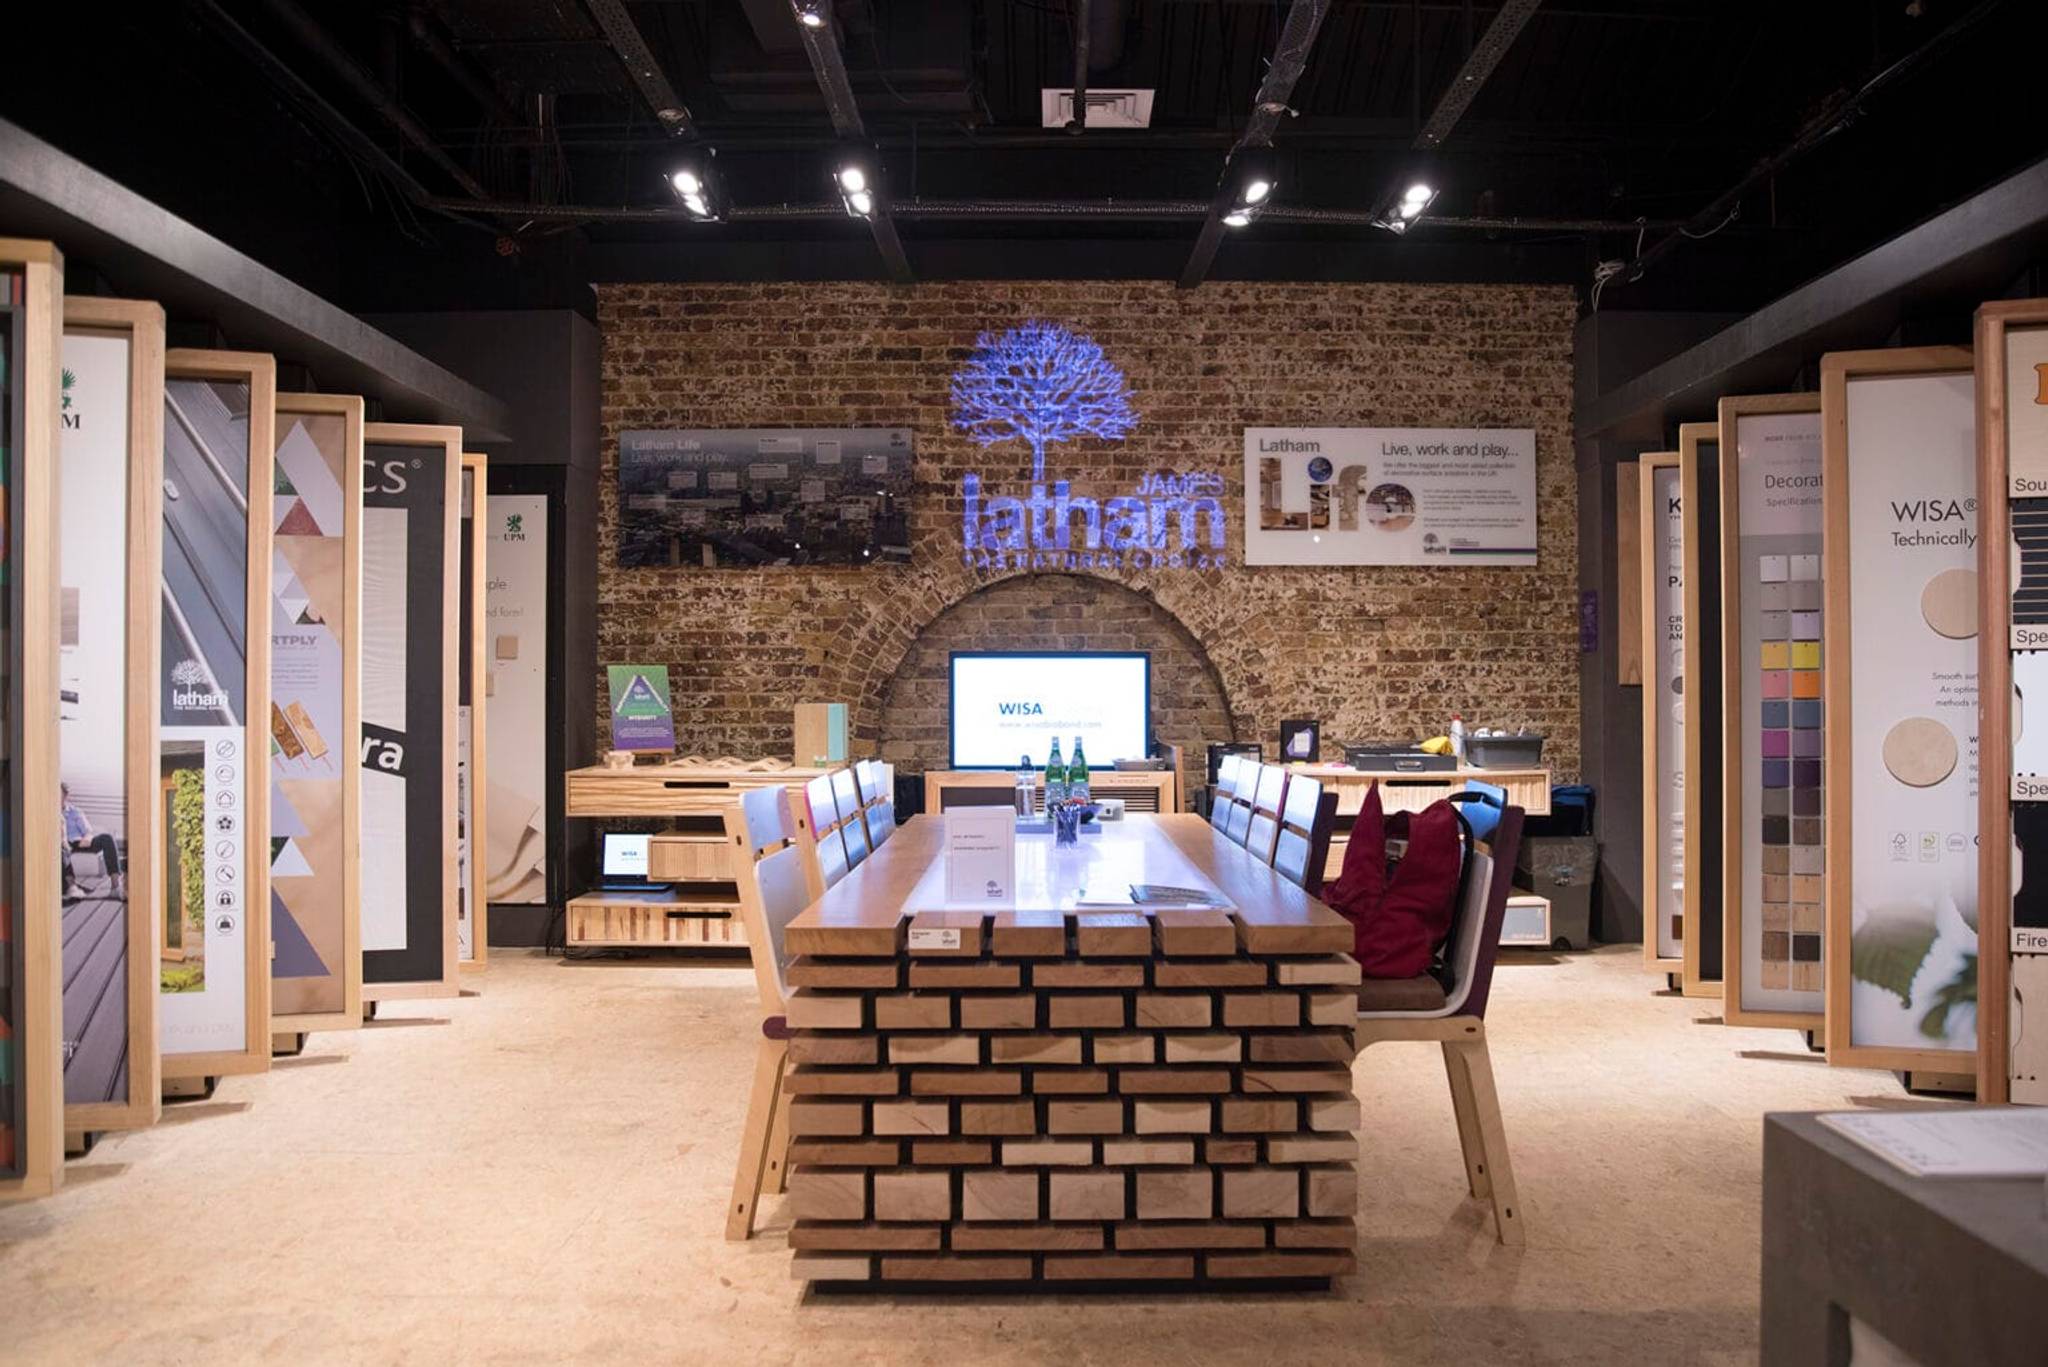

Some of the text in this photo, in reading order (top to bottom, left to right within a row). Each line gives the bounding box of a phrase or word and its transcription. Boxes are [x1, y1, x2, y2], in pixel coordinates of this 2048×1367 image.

[1259, 438, 1321, 453] Latham
[1382, 442, 1412, 457] Live,
[1415, 443, 1450, 456] work
[1452, 443, 1478, 456] and
[2015, 478, 2048, 492] Sou
[962, 472, 1227, 550] latham
[504, 533, 526, 542] UPM
[1891, 528, 1978, 549] Technically
[173, 689, 229, 706] latham
[999, 702, 1044, 715] WISA
